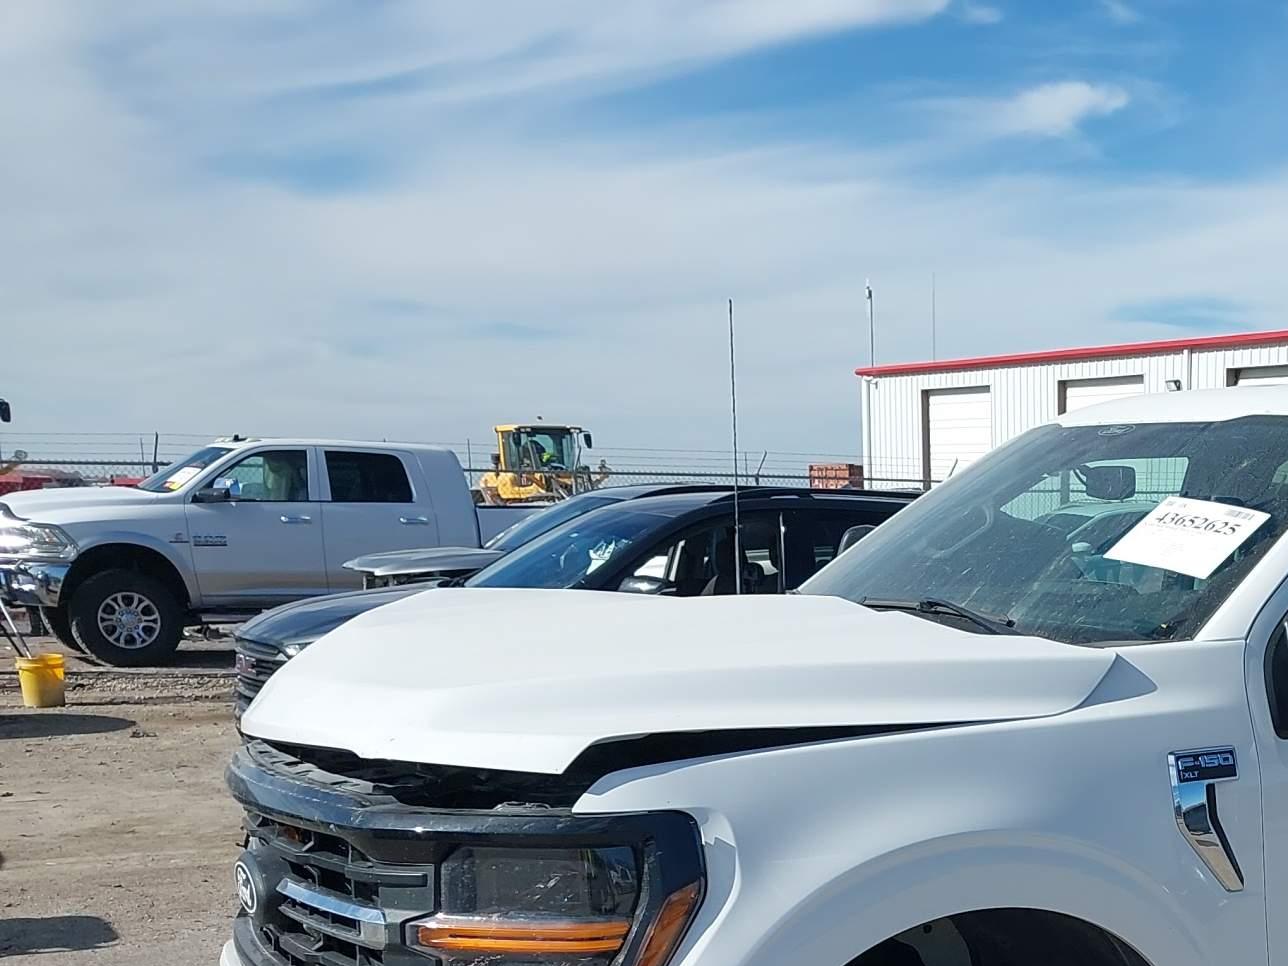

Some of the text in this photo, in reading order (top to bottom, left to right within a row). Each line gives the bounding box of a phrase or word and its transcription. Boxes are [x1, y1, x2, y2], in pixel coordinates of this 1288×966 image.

[1155, 511, 1242, 536] 43652625
[1178, 752, 1234, 771] F-150
[1183, 771, 1200, 779] XLT
[236, 865, 252, 907] Ford
